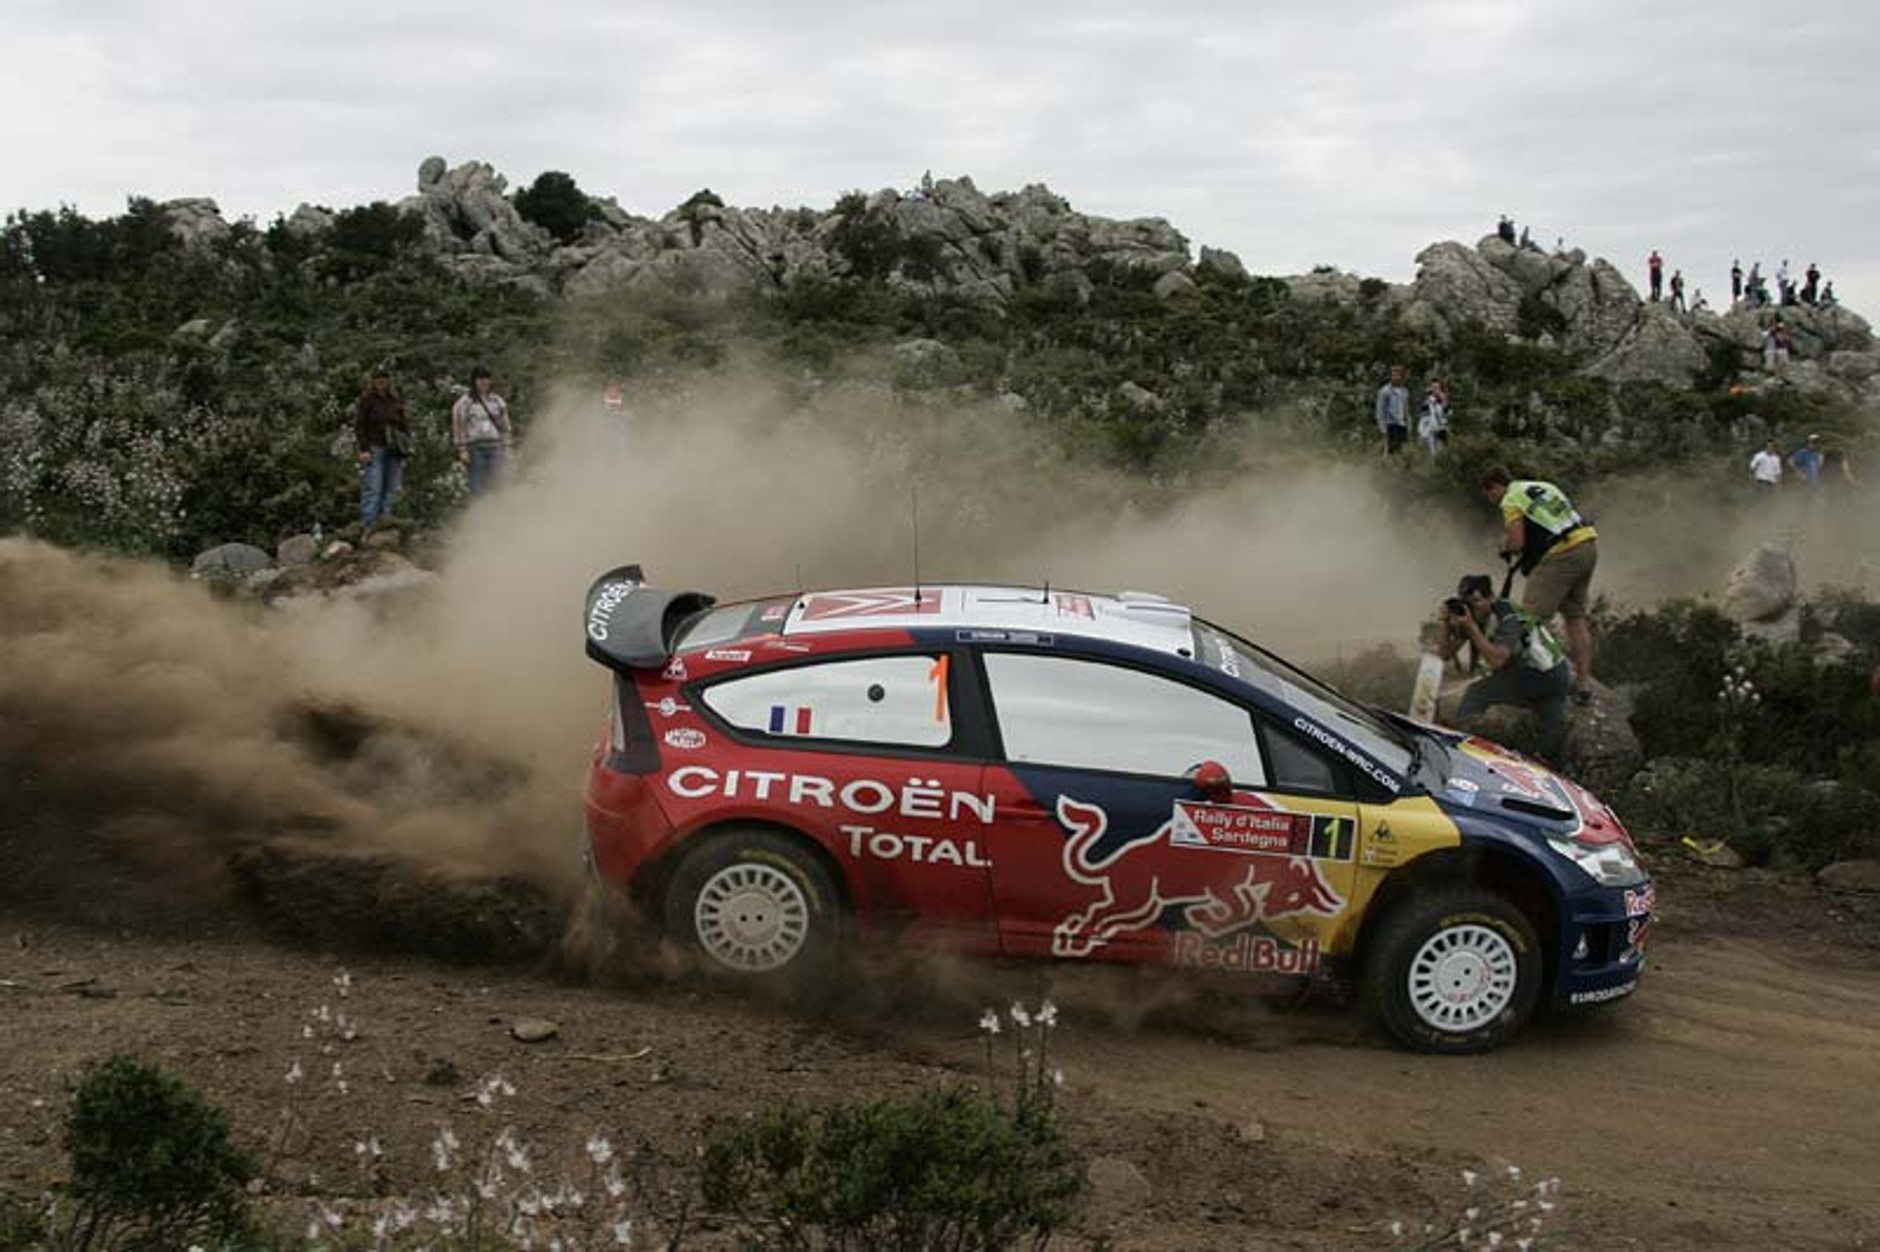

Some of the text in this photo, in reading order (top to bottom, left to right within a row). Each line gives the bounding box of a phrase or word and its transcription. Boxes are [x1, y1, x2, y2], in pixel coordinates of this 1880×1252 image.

[930, 655, 949, 721] 1
[667, 766, 996, 824] CITROËN
[1193, 808, 1233, 829] Rally
[1211, 826, 1287, 849] Sardegna
[1324, 817, 1341, 858] 1
[840, 824, 993, 867] TOTAL
[1175, 931, 1322, 975] Red Bull
